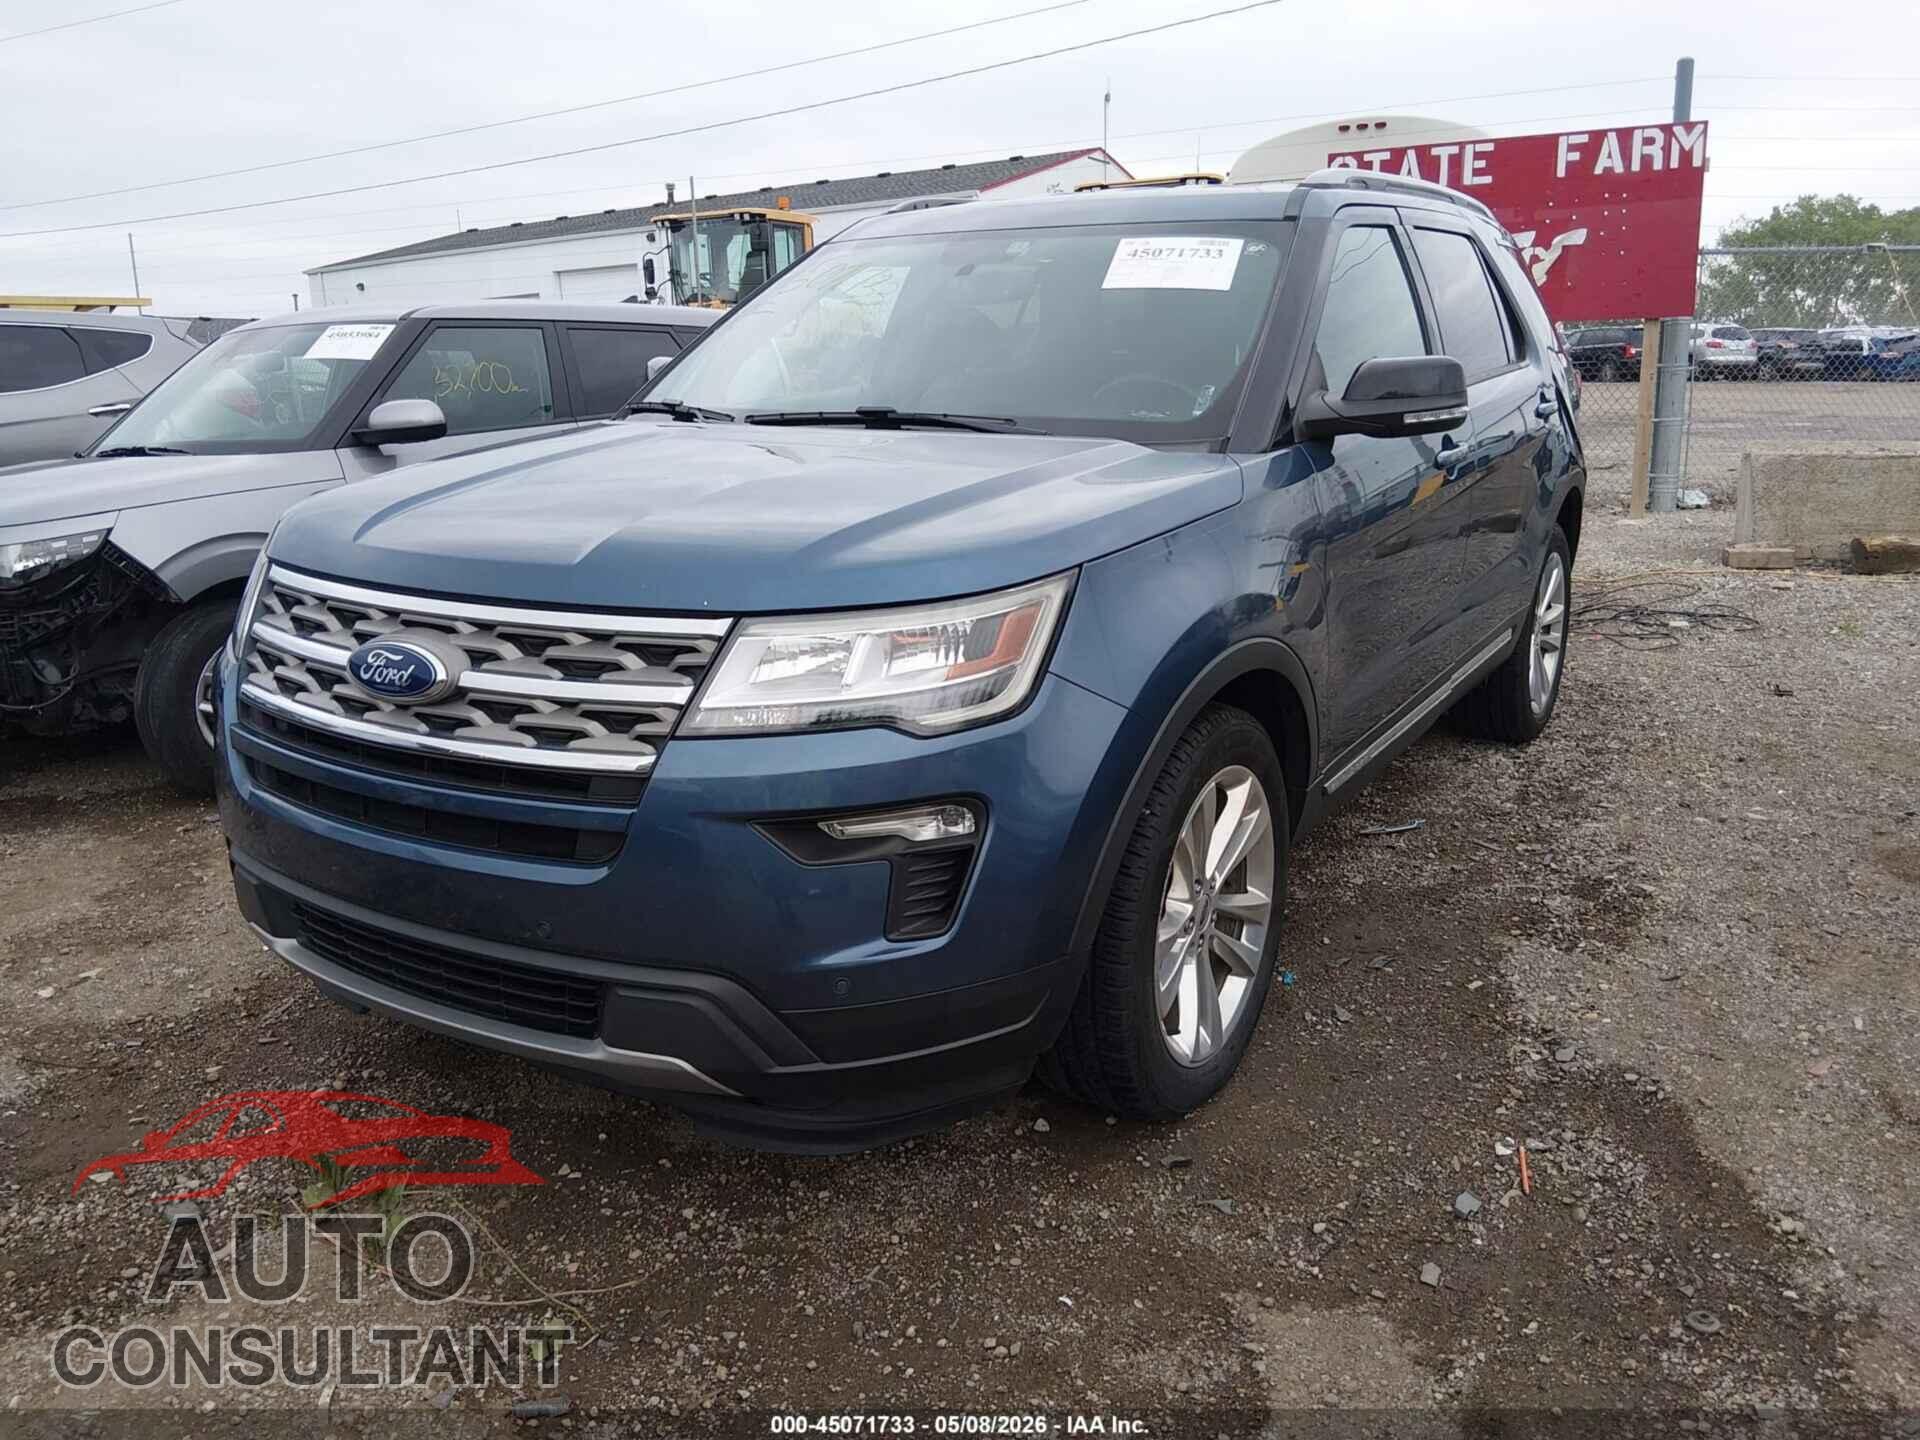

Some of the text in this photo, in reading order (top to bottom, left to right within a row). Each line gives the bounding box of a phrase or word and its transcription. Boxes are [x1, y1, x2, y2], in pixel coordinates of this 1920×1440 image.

[1329, 123, 1705, 186] TATE FARM
[1127, 247, 1224, 260] 45071733
[360, 649, 416, 687] Ford
